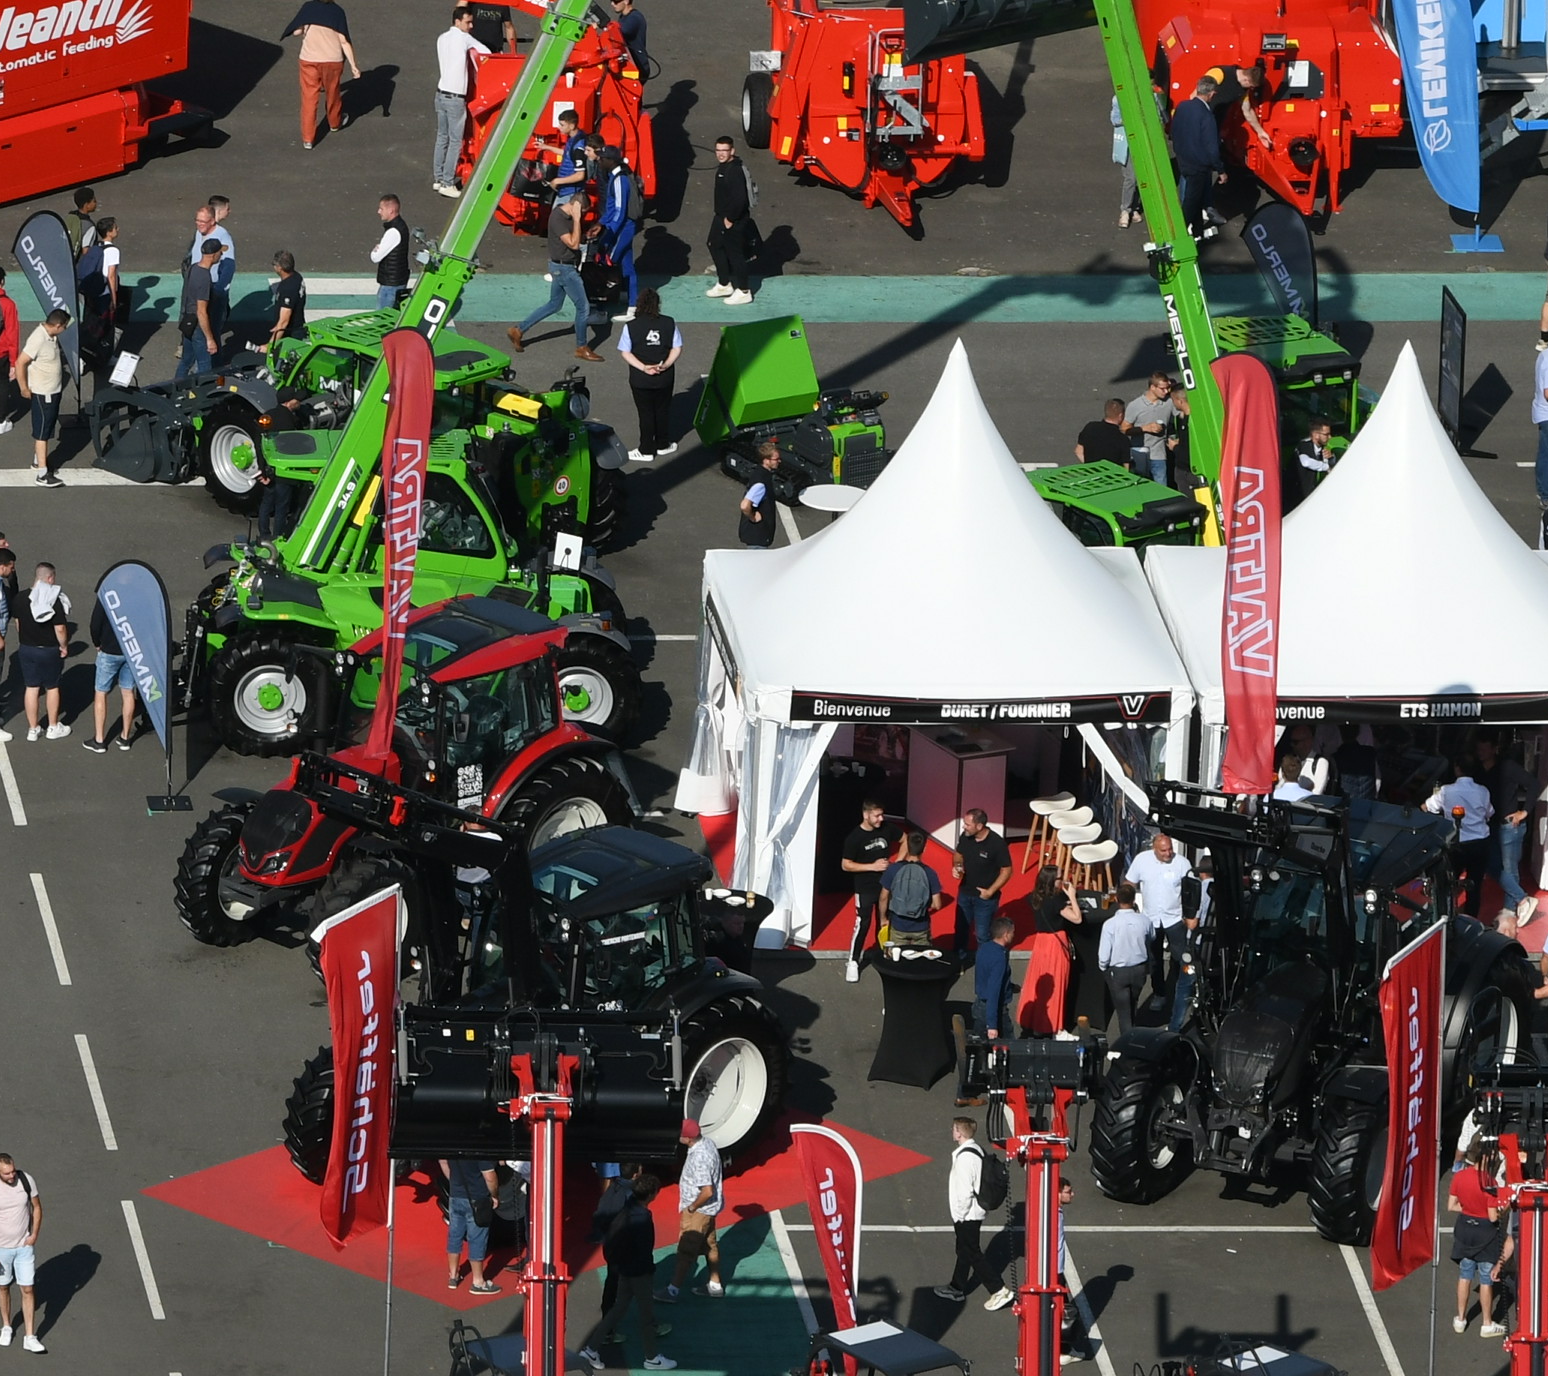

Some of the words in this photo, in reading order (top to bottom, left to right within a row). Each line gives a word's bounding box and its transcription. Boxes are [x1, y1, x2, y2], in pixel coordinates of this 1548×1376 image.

[1164, 294, 1195, 390] MERLO
[813, 699, 891, 718] Bienvenue
[940, 703, 988, 718] DURET
[998, 702, 1071, 718] FOURNIER
[1400, 702, 1428, 718] ETS
[1430, 702, 1482, 718] HAMON
